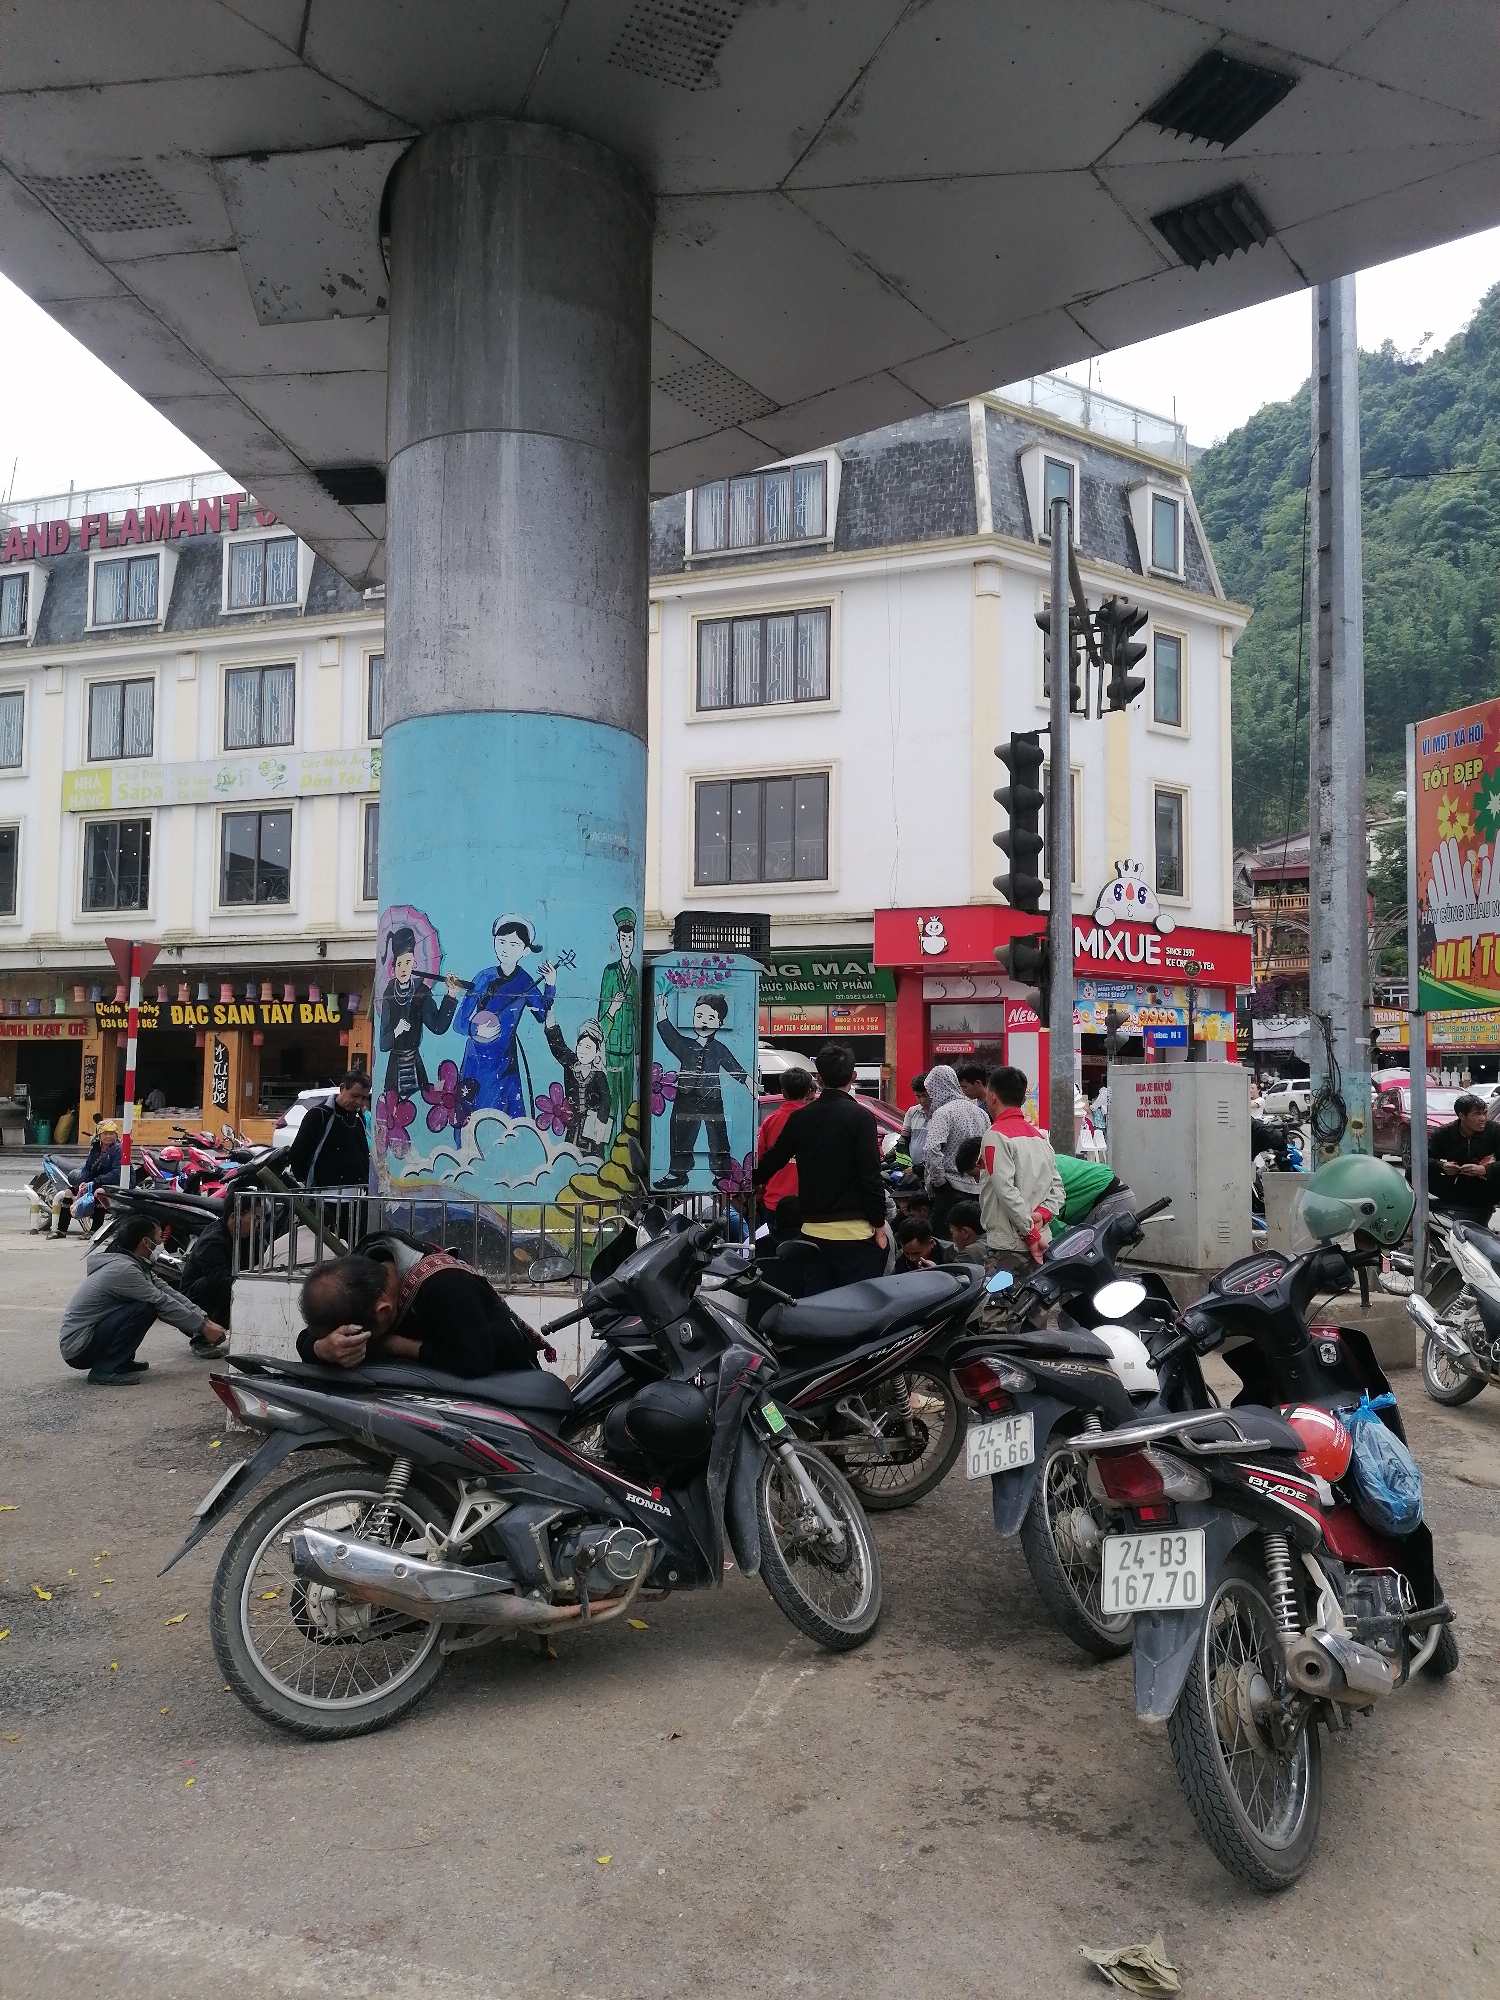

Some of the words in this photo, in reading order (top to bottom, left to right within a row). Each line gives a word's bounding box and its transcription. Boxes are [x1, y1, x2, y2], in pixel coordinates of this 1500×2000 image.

[80, 493, 246, 551] FLAMANT
[1422, 735, 1430, 756] VÌ
[1432, 730, 1451, 755] MỘT
[1468, 721, 1484, 746] HỘI
[74, 773, 101, 790] NHÀ
[1422, 761, 1450, 791] TỐT
[1453, 758, 1483, 786] ĐẸP
[117, 783, 164, 803] Sapa
[1465, 901, 1490, 921] NHAU
[1074, 926, 1162, 965] MIXUE
[1165, 947, 1182, 956] SINCE
[1202, 961, 1215, 971] TEA
[1434, 936, 1472, 982] MA
[785, 980, 816, 991] NĂNG
[823, 979, 838, 990] MỸ
[100, 1018, 116, 1028] 034
[141, 1018, 158, 1028] 862
[259, 999, 294, 1024] TÂY
[1374, 1011, 1400, 1023] TRANG
[1040, 1360, 1089, 1373] BLADE
[977, 1418, 1023, 1451] 24-AF
[972, 1440, 1029, 1475] 016.66
[1248, 1475, 1308, 1502] BLADE
[625, 1492, 672, 1517] HONDA
[1119, 1536, 1188, 1571] 24-B3
[1111, 1570, 1197, 1608] 167.70
